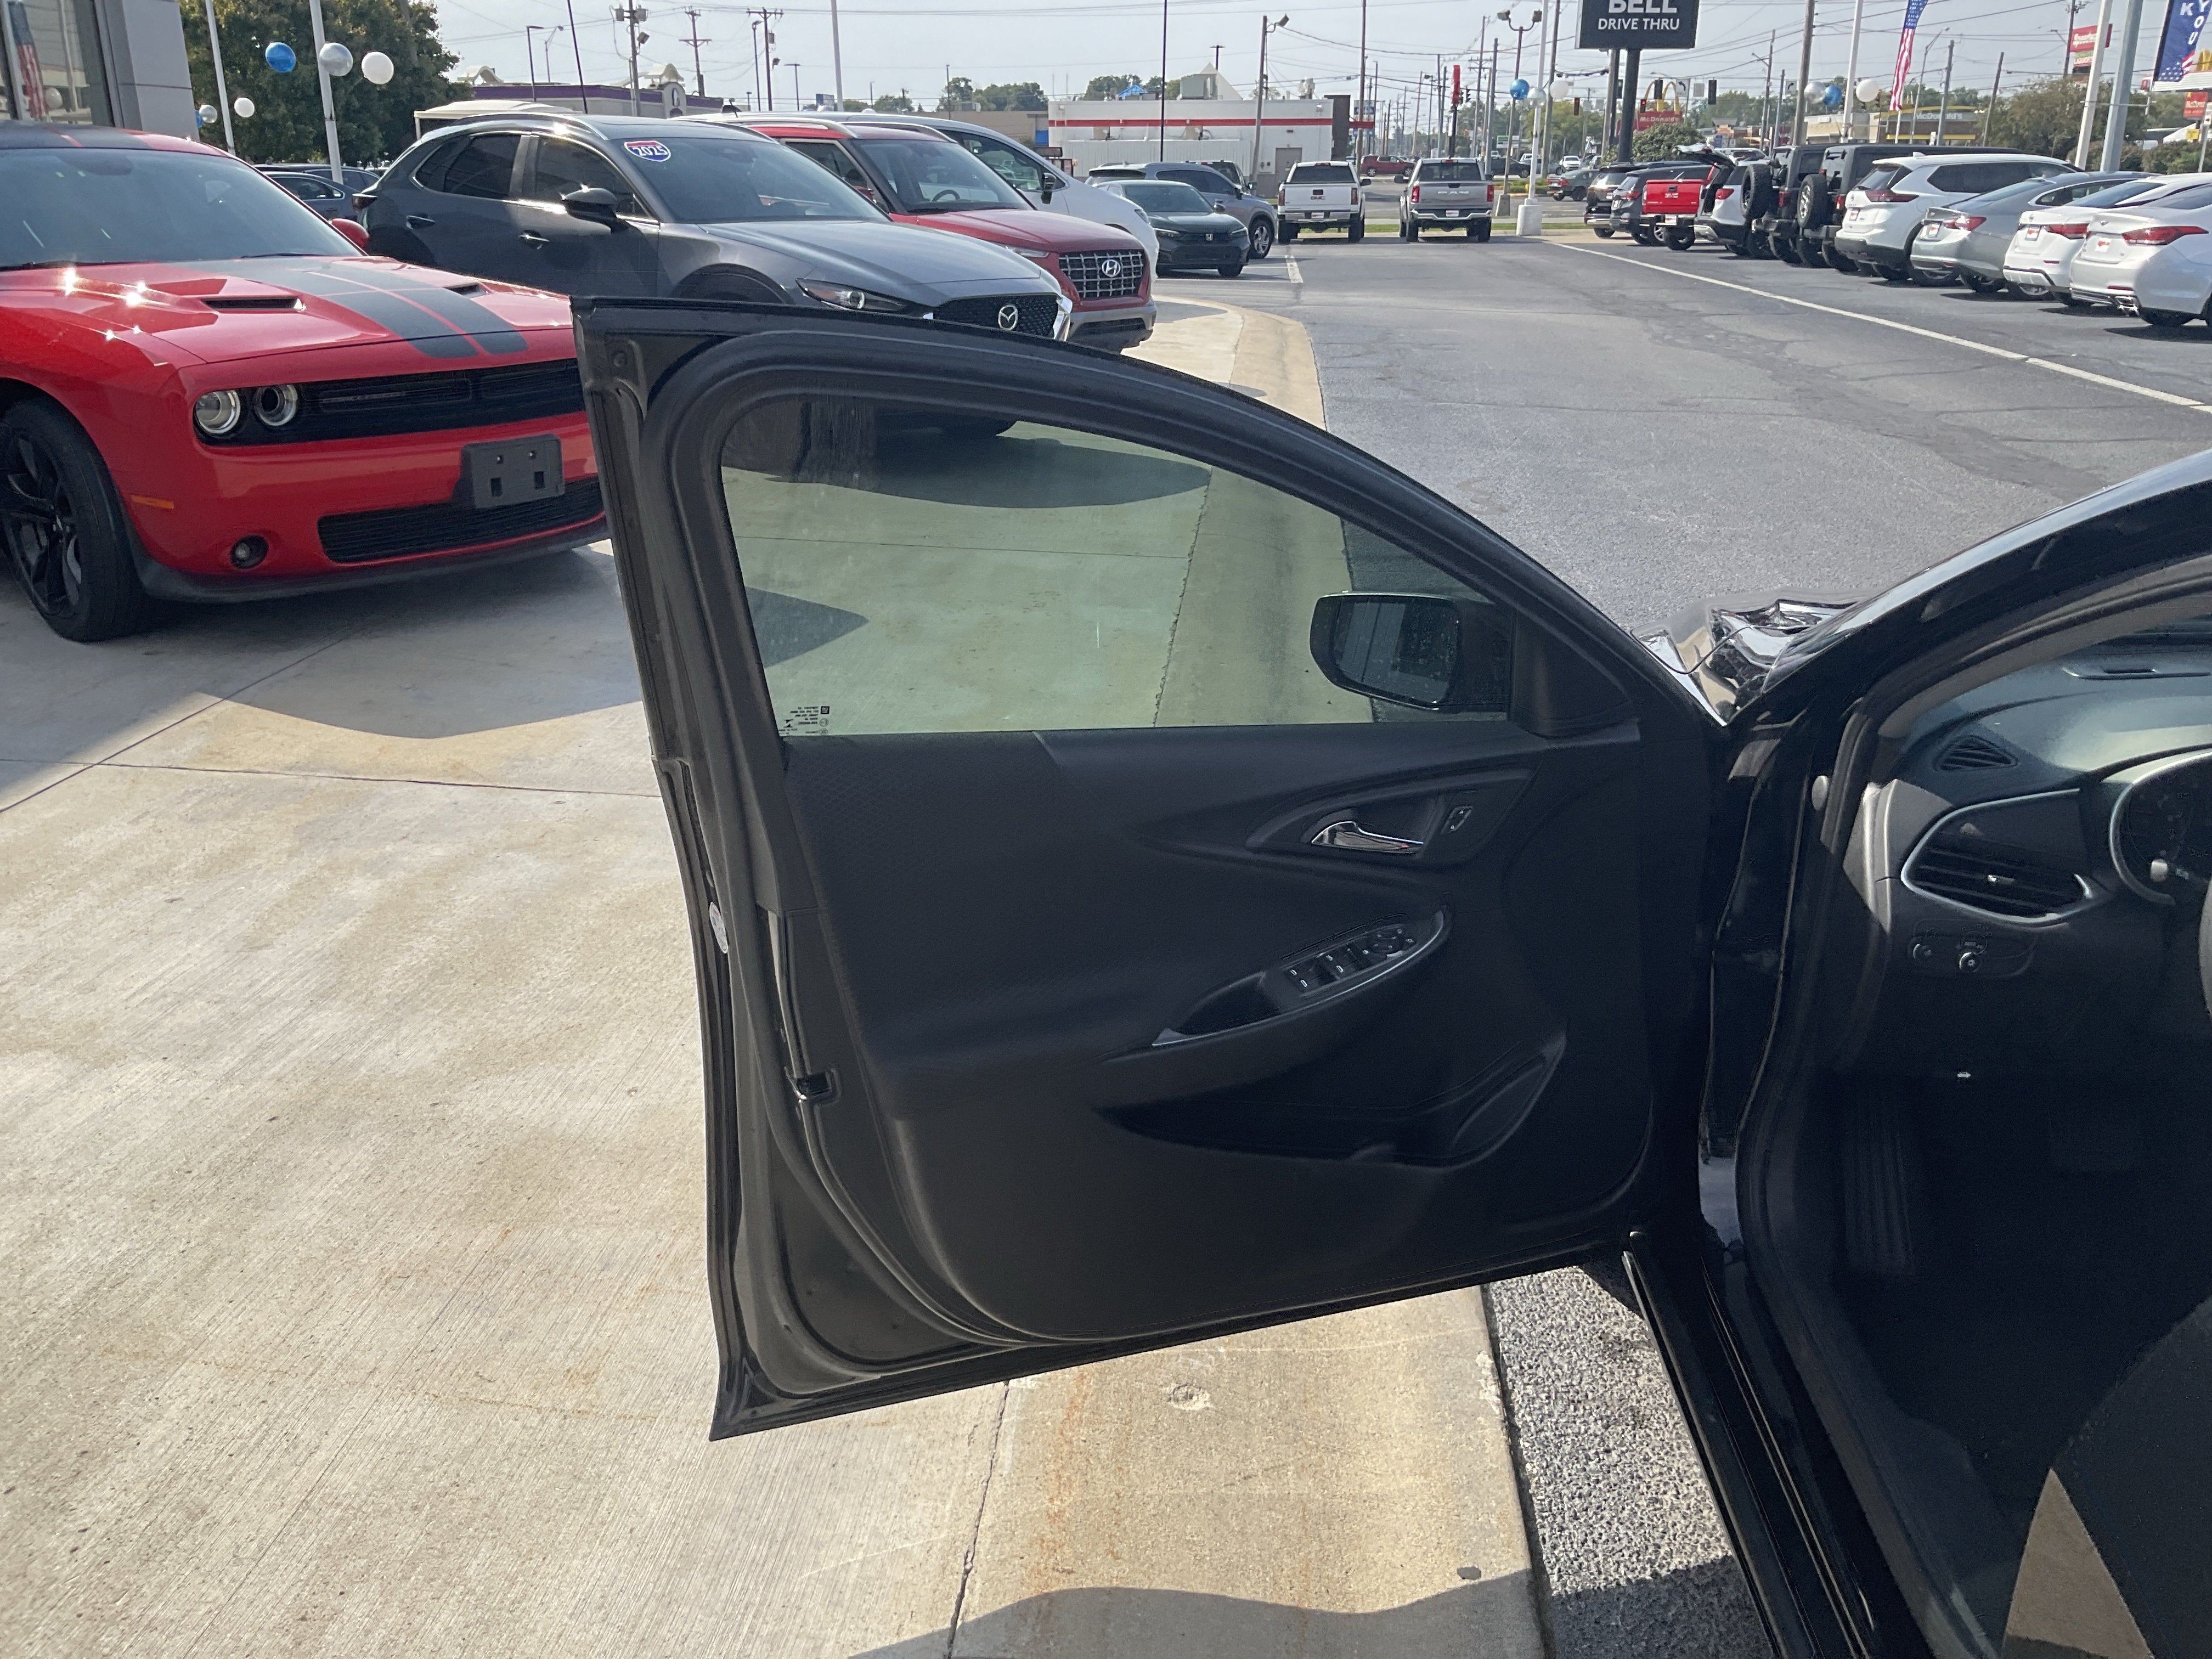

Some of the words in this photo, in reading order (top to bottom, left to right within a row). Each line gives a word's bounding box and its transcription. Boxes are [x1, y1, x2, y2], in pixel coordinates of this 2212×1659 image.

[1608, 0, 1677, 13] BELL
[1598, 18, 1639, 30] DRIVE
[1642, 18, 1680, 30] THRU
[633, 146, 668, 156] 2025
